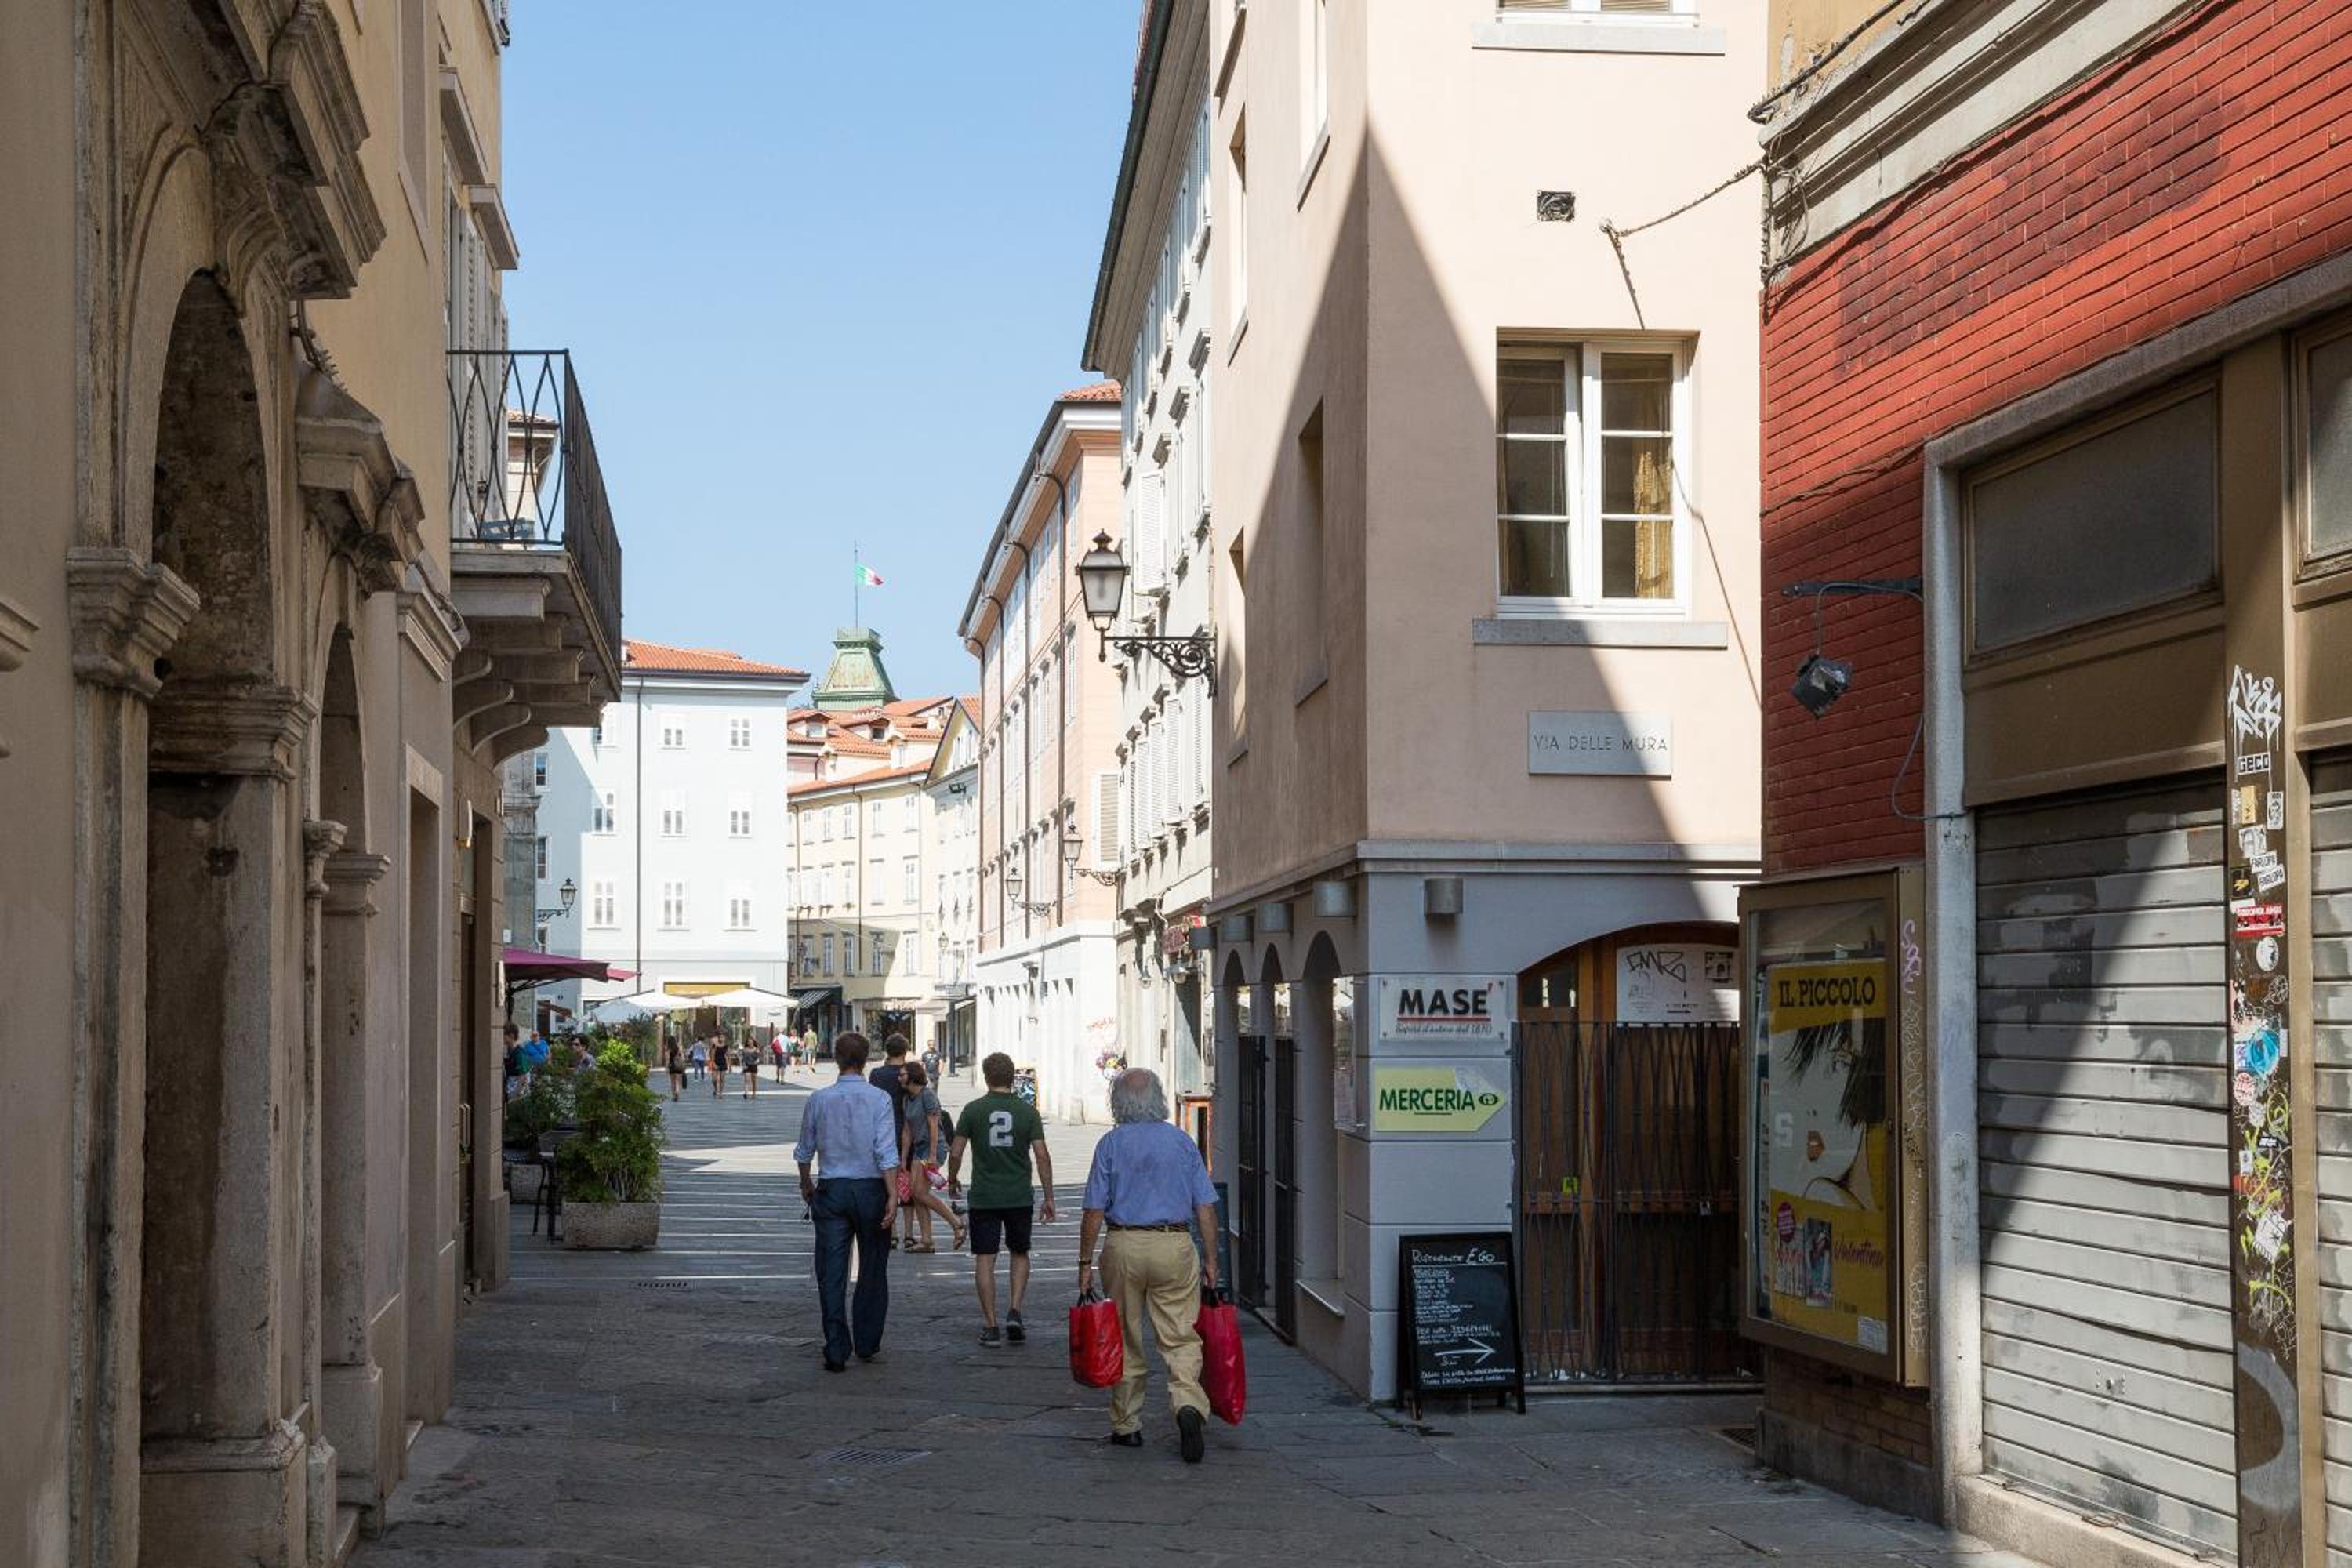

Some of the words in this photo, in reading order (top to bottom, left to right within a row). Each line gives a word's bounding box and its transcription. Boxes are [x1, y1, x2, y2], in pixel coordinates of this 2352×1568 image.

[1534, 735, 1559, 750] VIA
[1569, 735, 1613, 750] DELLE
[1622, 737, 1668, 751] MURA
[1779, 980, 1795, 1007] IL
[1798, 976, 1876, 1007] PICCOLO
[1379, 1088, 1475, 1111] MERCERIA
[989, 1111, 1014, 1147] 2
